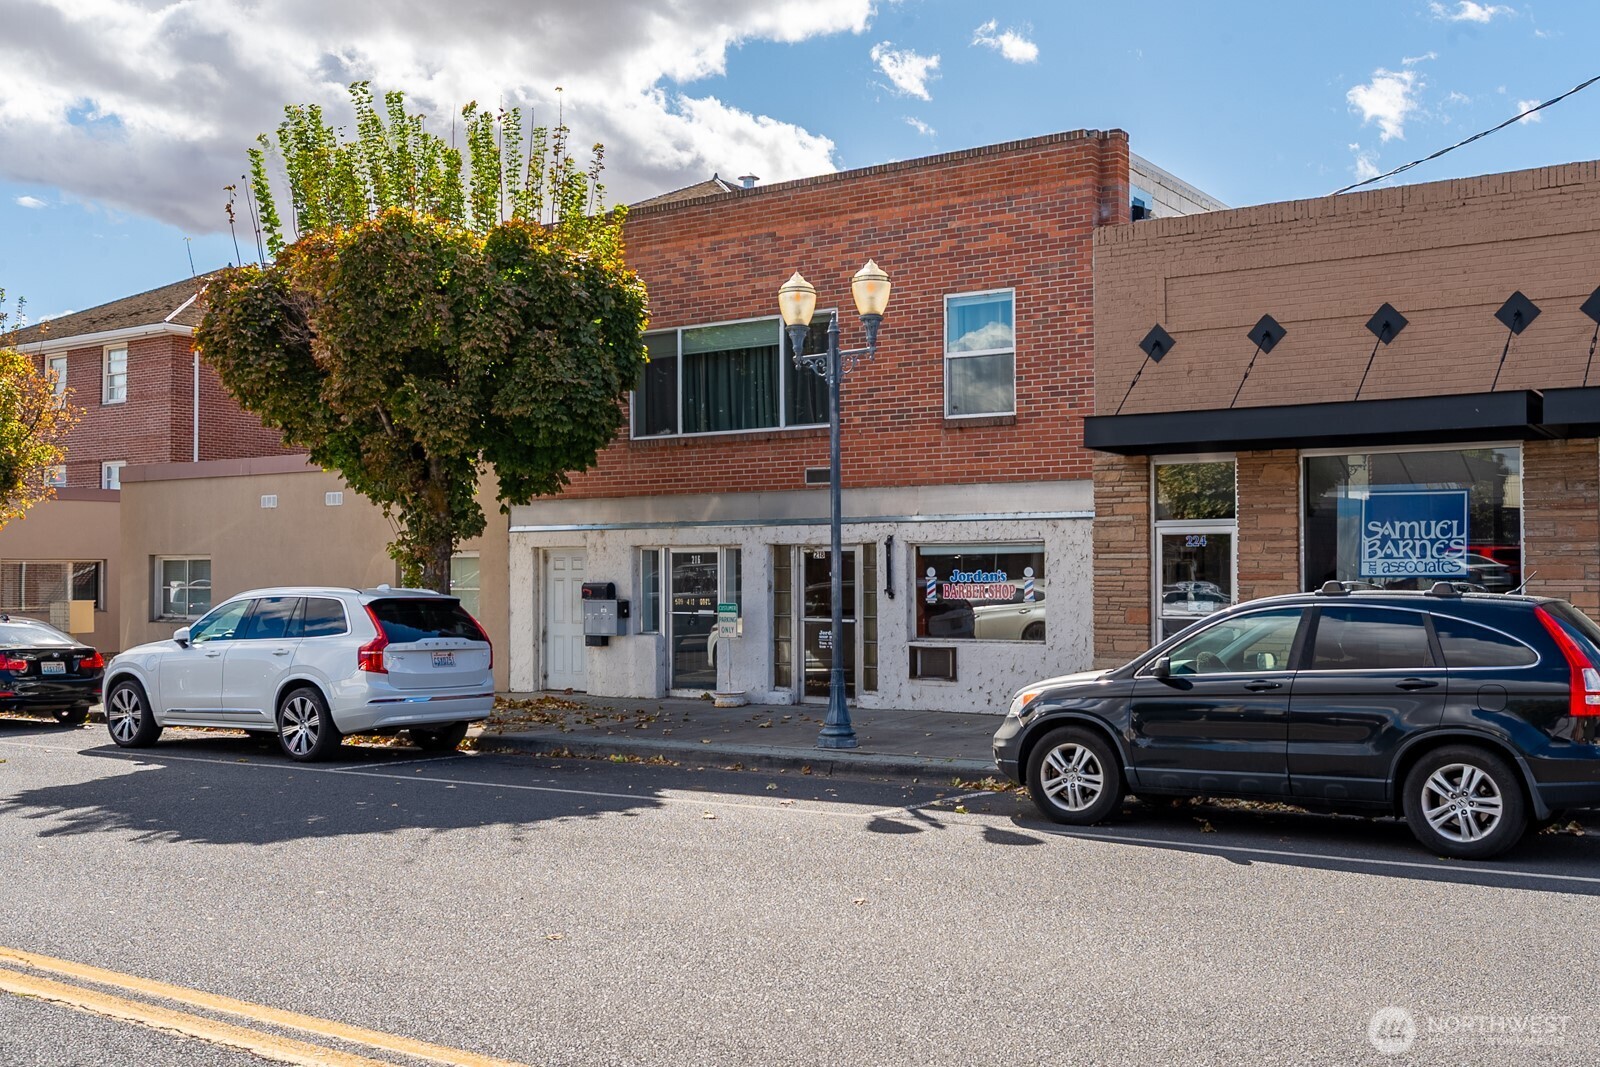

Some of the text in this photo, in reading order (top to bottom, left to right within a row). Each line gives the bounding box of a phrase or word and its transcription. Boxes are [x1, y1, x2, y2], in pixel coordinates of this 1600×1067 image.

[1364, 520, 1465, 540] SAMUEL
[1186, 535, 1207, 547] 224
[1364, 539, 1465, 561] BARNES
[1381, 560, 1462, 574] associates
[949, 569, 1007, 582] Jordan's
[943, 583, 1016, 600] BARBER SHOP
[721, 626, 734, 634] ONLY
